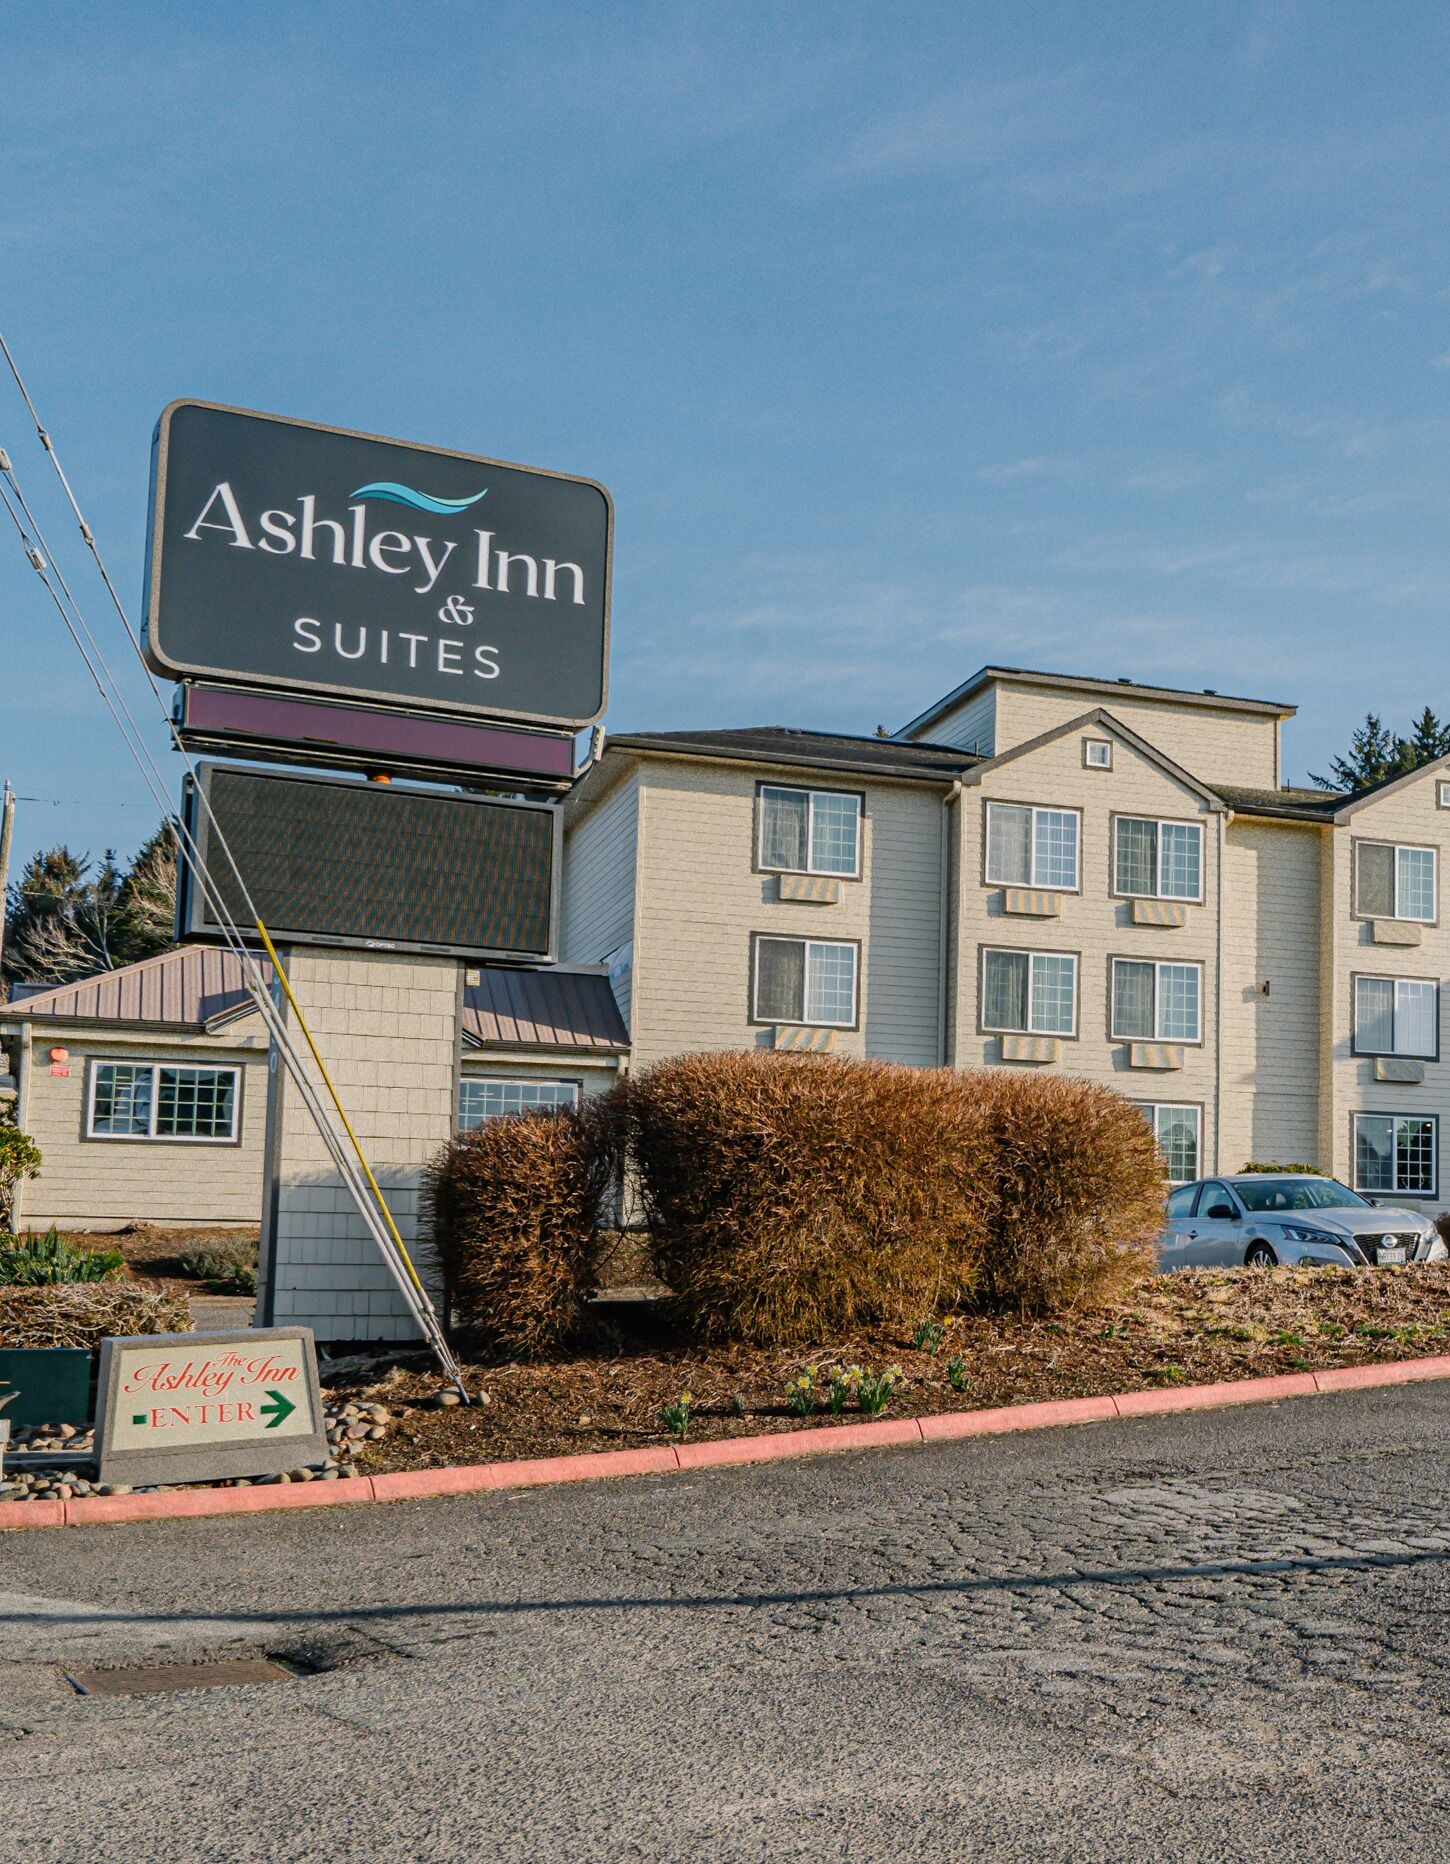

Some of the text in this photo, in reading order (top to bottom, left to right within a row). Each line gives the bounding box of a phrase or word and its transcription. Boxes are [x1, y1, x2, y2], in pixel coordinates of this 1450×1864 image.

[183, 482, 586, 605] Ashley Inn
[438, 595, 475, 626] &
[292, 617, 500, 679] SUITES
[123, 1355, 303, 1398] Ashley Inn
[212, 1351, 247, 1367] The
[150, 1402, 256, 1428] ENTER
